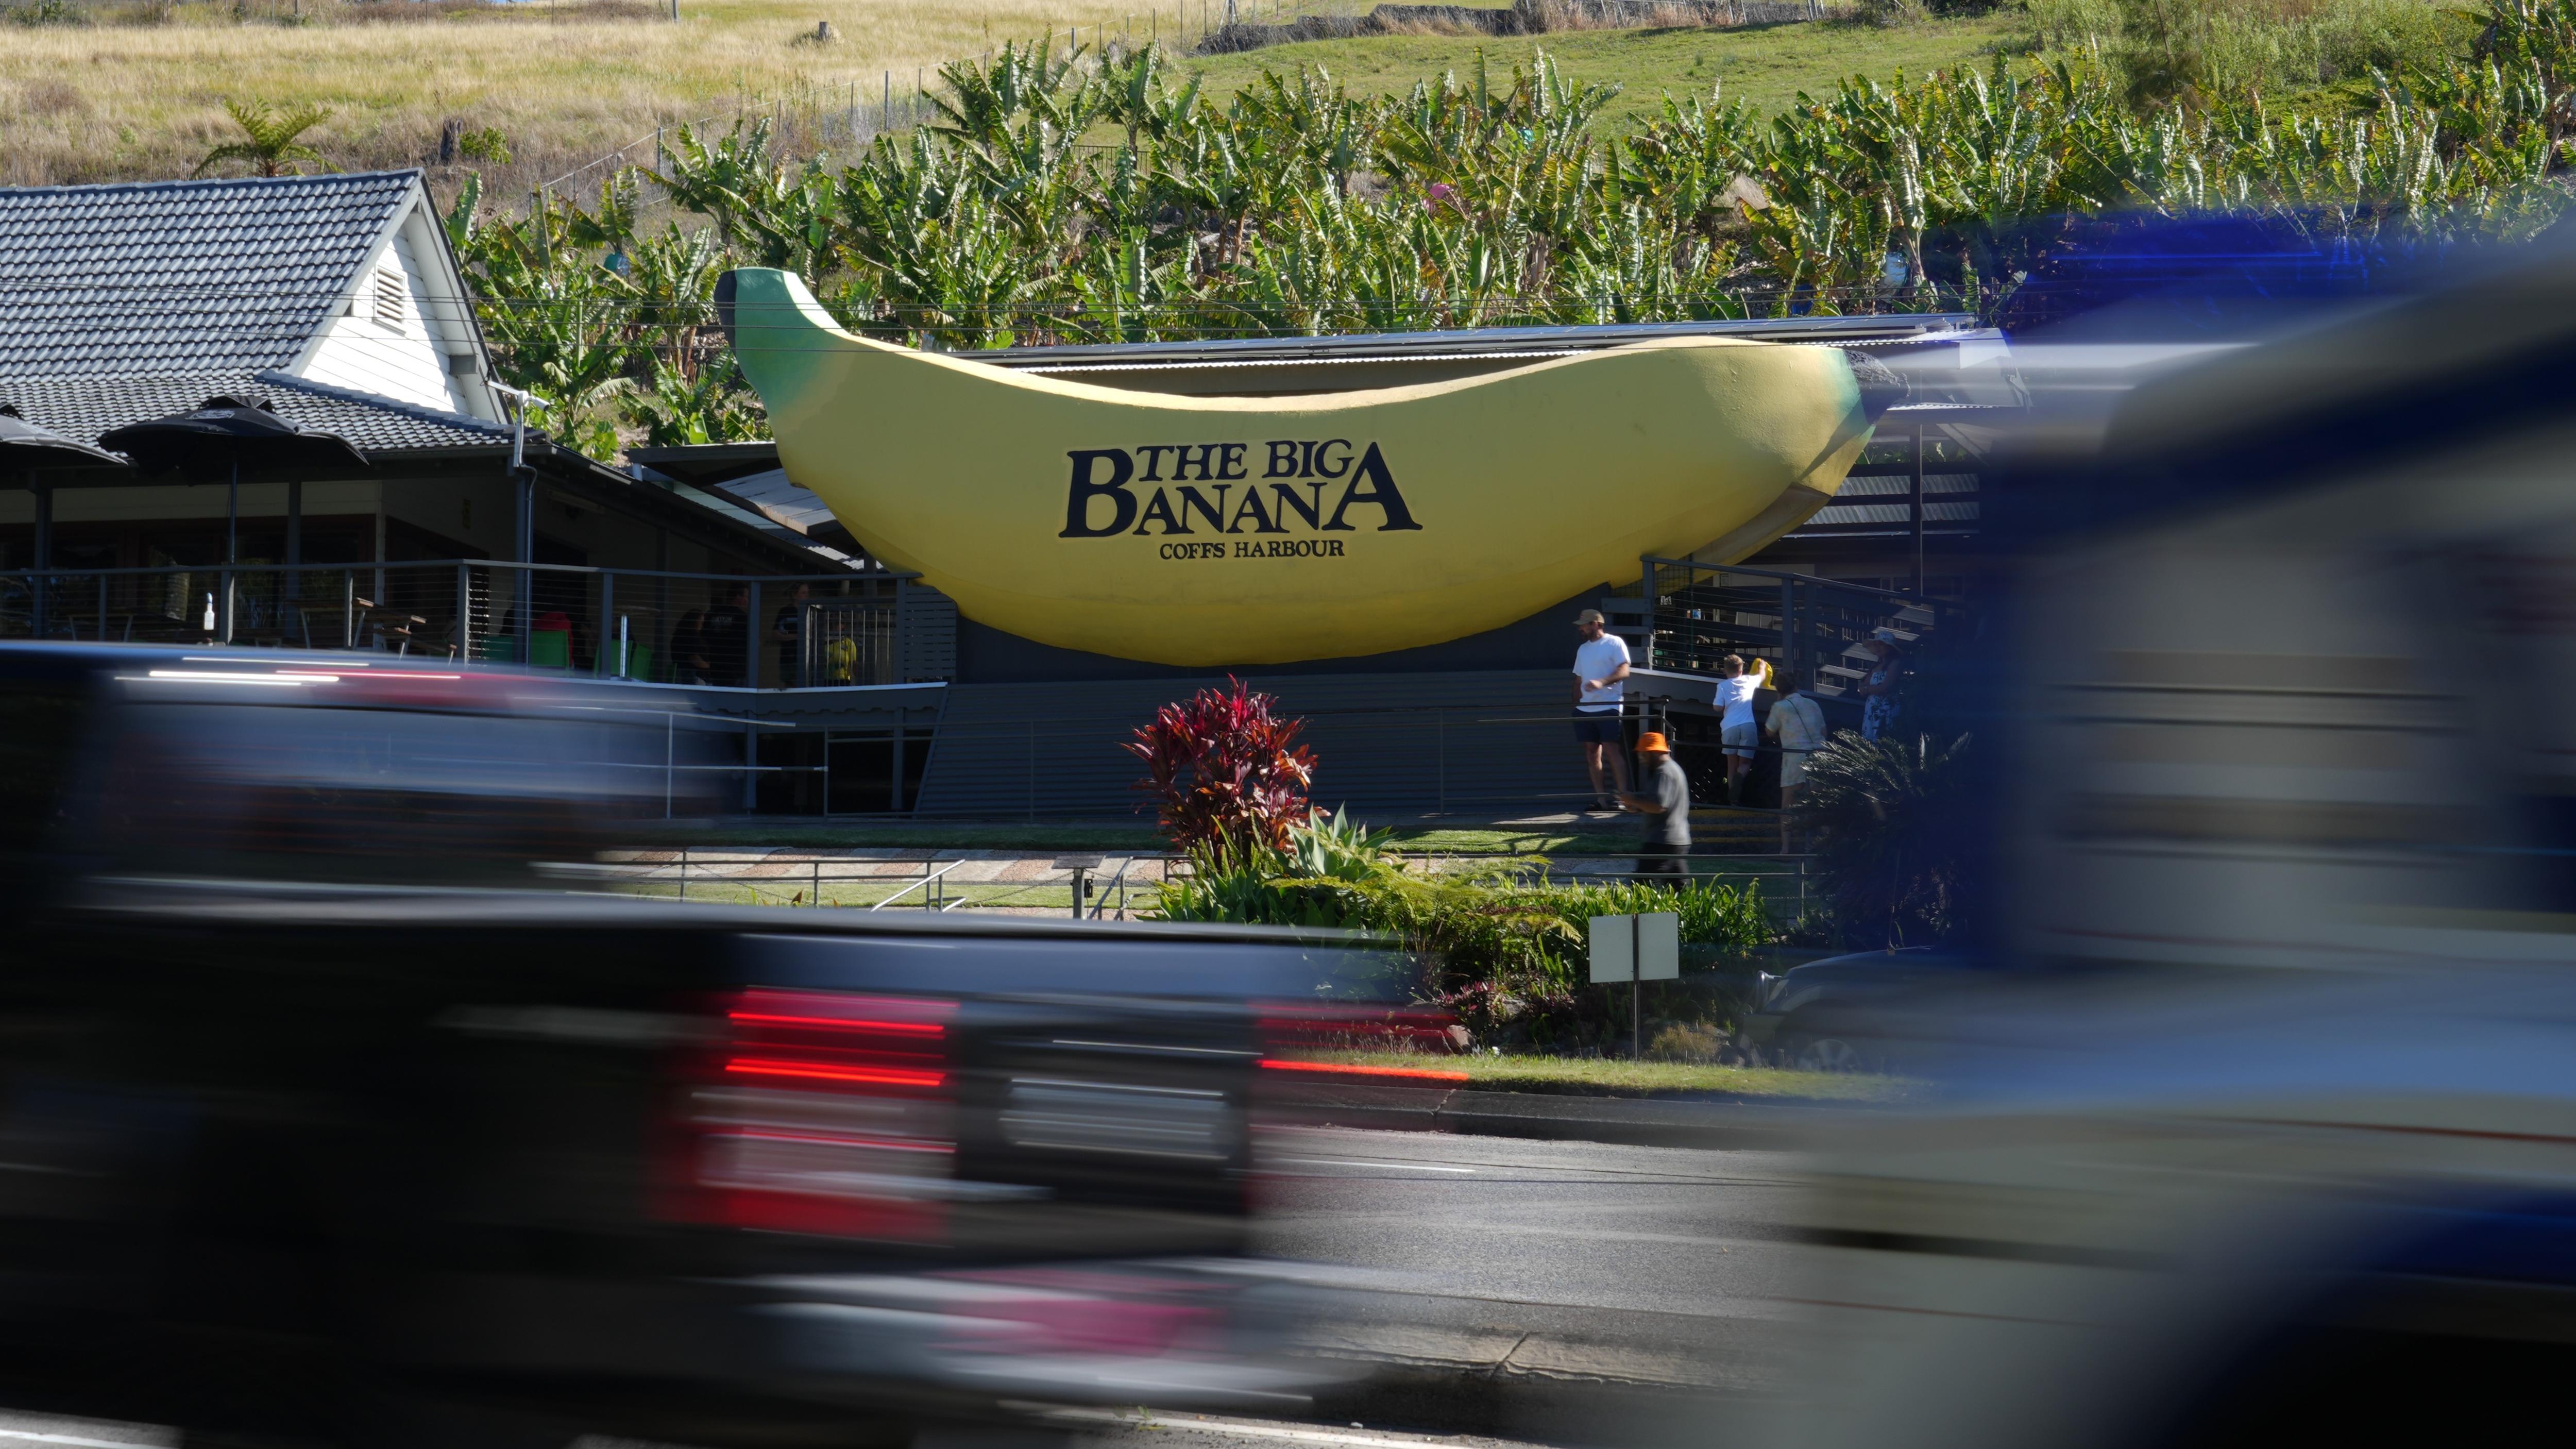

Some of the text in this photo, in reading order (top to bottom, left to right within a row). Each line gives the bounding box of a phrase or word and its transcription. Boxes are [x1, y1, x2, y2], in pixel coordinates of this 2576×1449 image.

[1136, 439, 1355, 482] THE BIG
[1058, 442, 1423, 538] BANANA
[1160, 540, 1345, 560] COFFS HARBOUR
